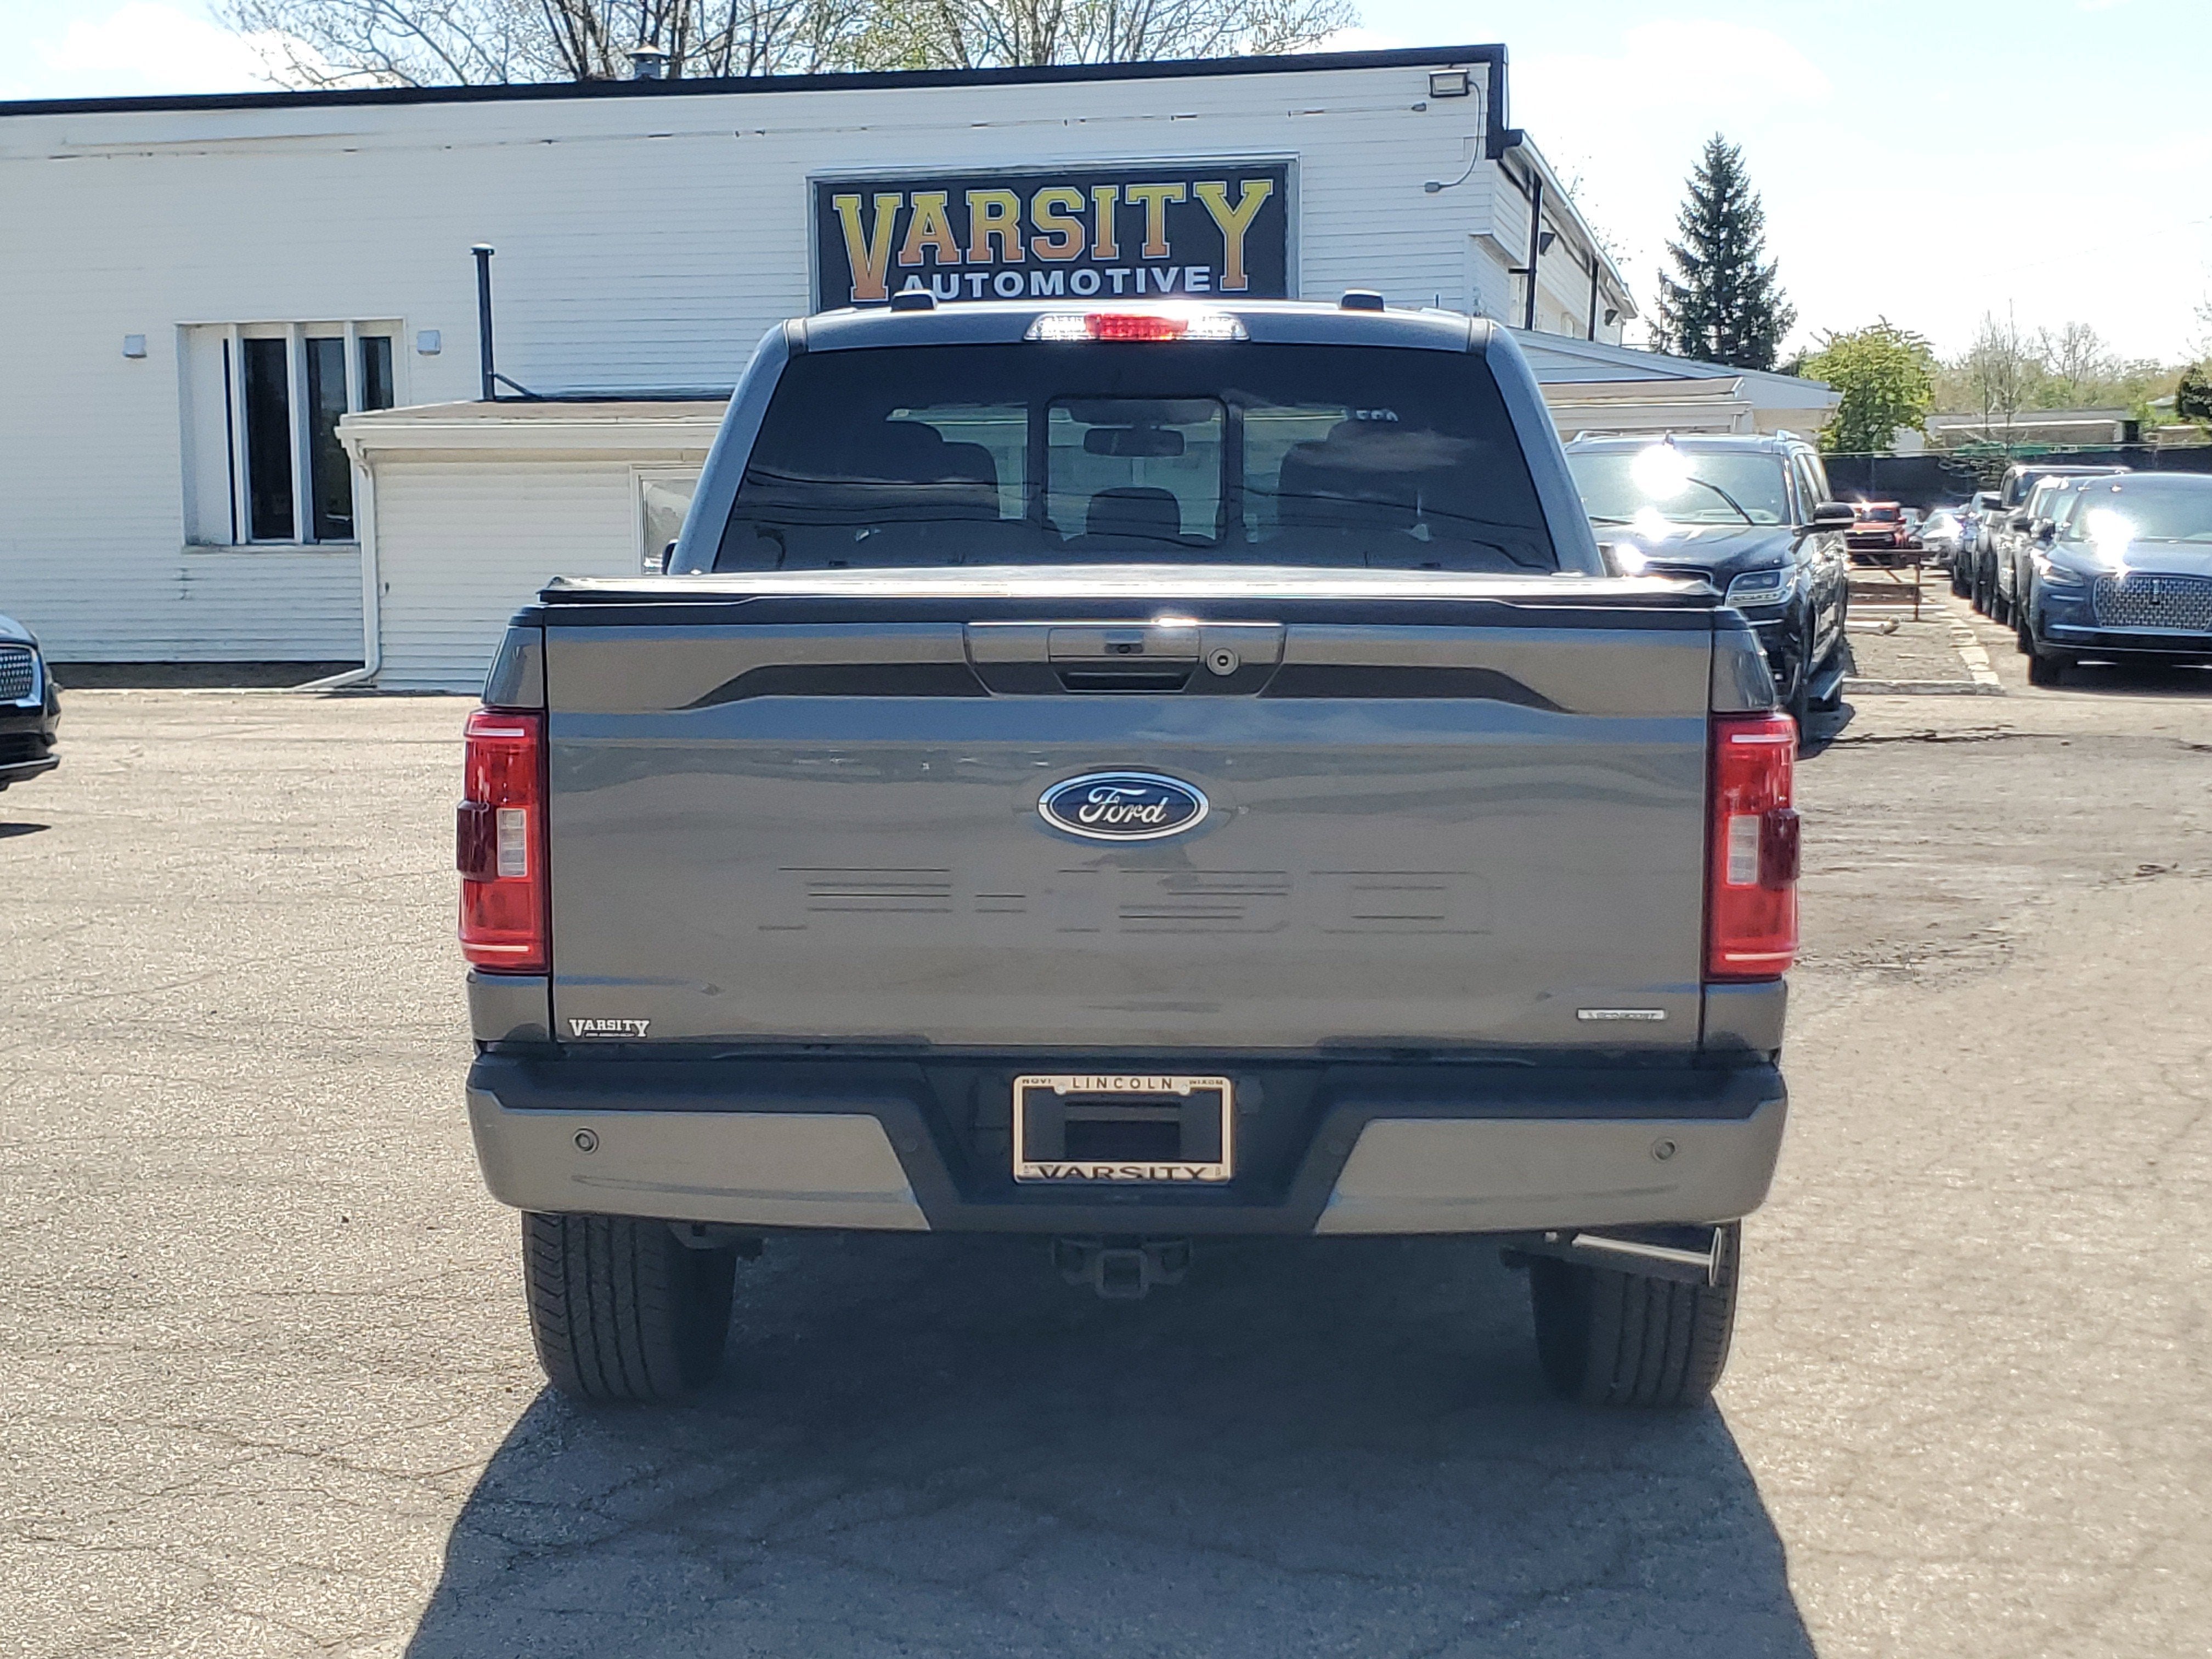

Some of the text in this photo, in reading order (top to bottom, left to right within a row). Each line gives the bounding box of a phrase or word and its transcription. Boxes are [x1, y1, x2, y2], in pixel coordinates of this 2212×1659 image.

[832, 178, 1274, 302] VARSITY
[902, 266, 1211, 300] AUTOMOTIVE
[1079, 786, 1169, 823] Ford
[568, 1019, 650, 1037] VARSITY
[1073, 1077, 1172, 1090] LINCOLN
[1037, 1165, 1207, 1180] VARSITY
